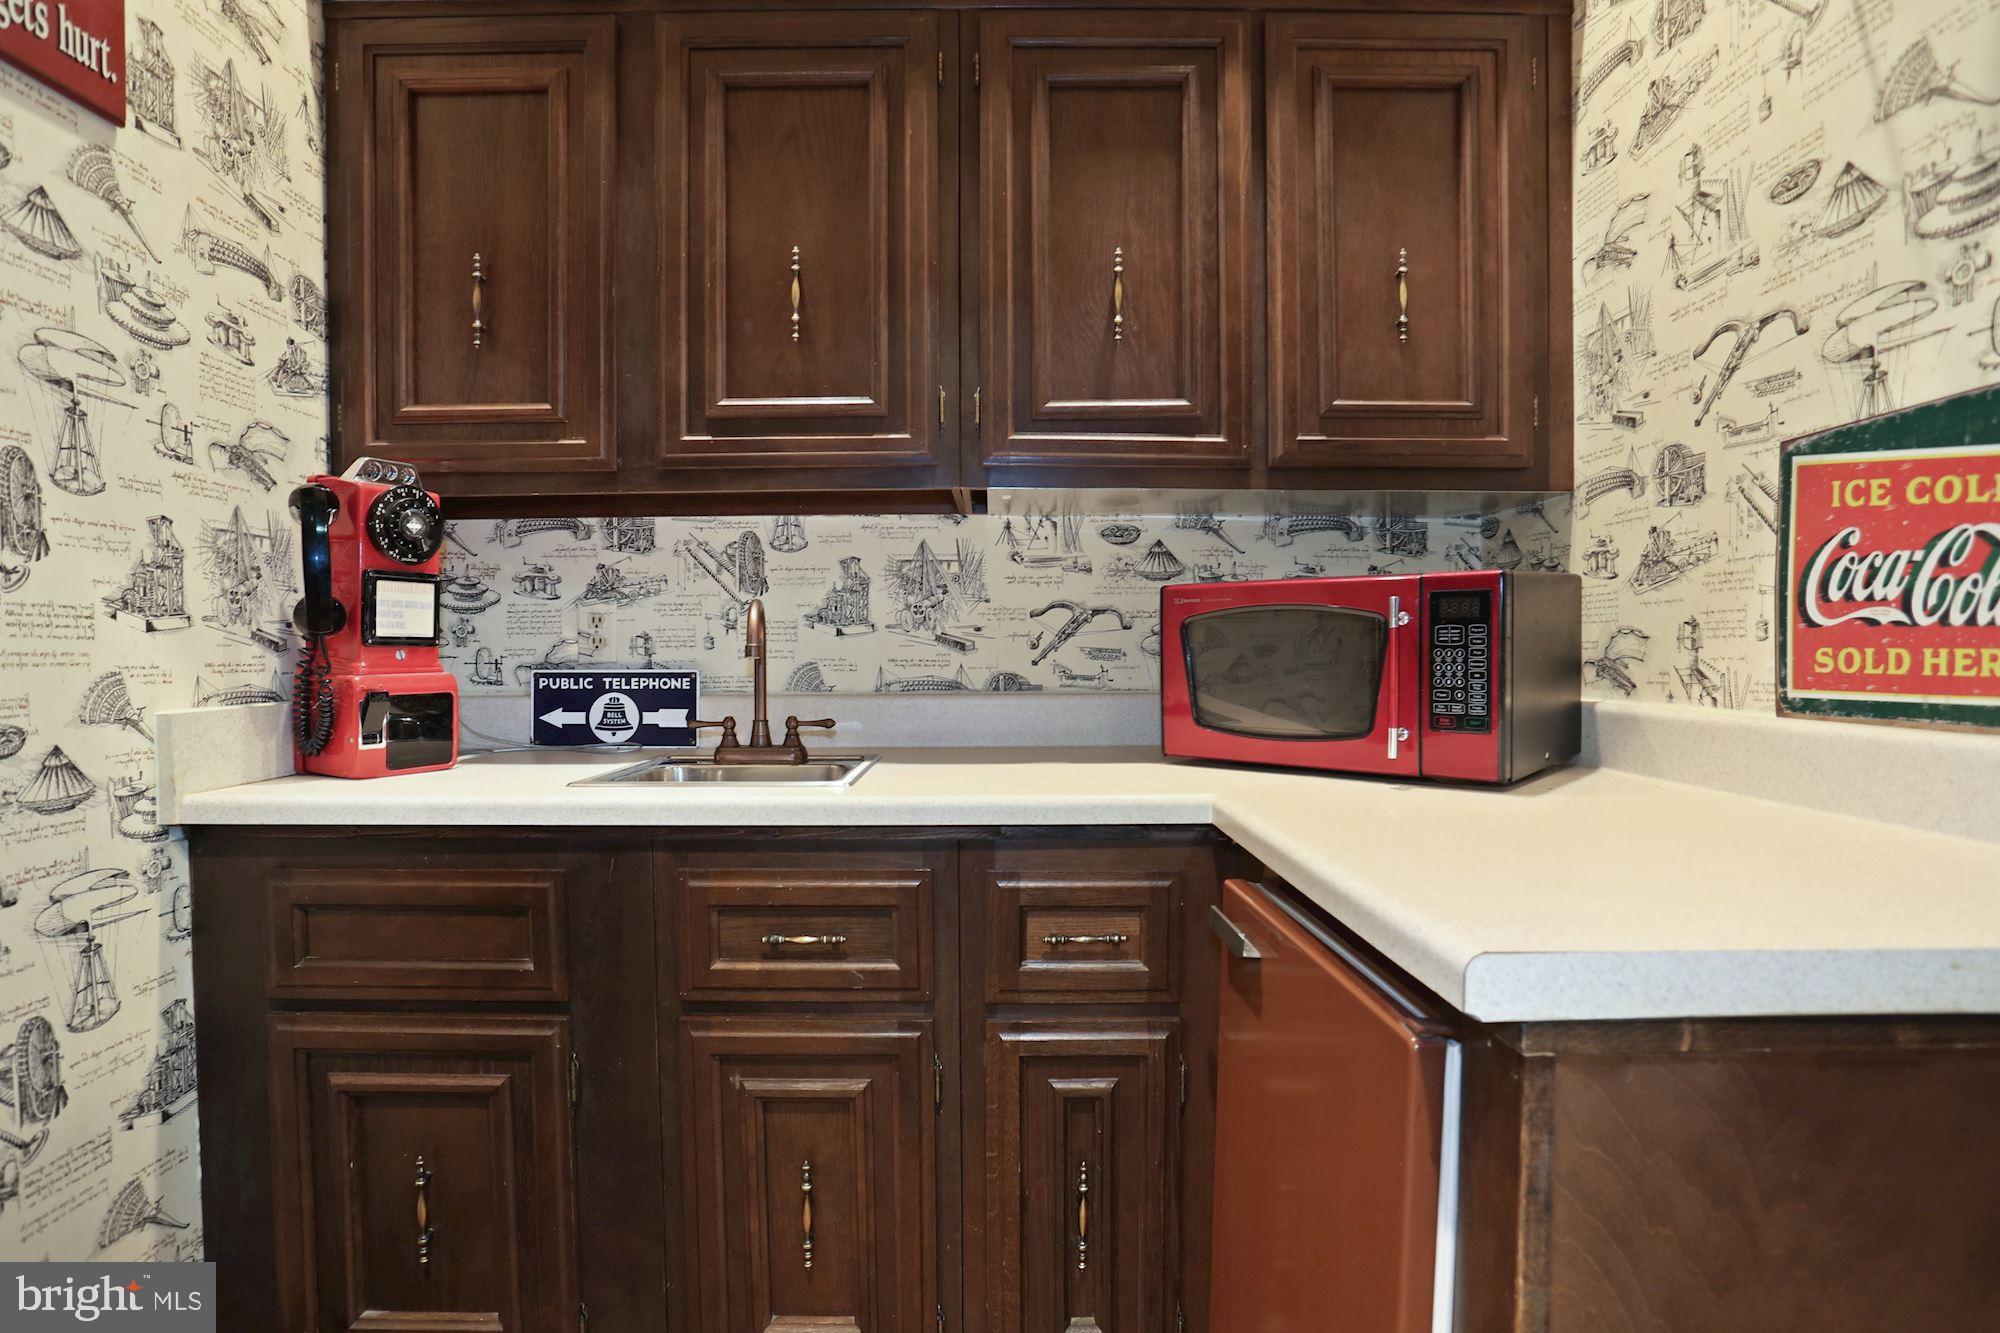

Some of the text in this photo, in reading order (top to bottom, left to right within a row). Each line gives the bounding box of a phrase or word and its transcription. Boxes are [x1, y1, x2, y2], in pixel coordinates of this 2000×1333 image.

[0, 0, 49, 39] ets
[58, 3, 117, 83] hurt.
[1831, 473, 2000, 507] ICE COL
[1805, 522, 2000, 626] Coca-Col
[1814, 647, 1911, 675] SOLD
[538, 677, 691, 690] PUBLIC TELEPHONE
[607, 711, 622, 719] BELL
